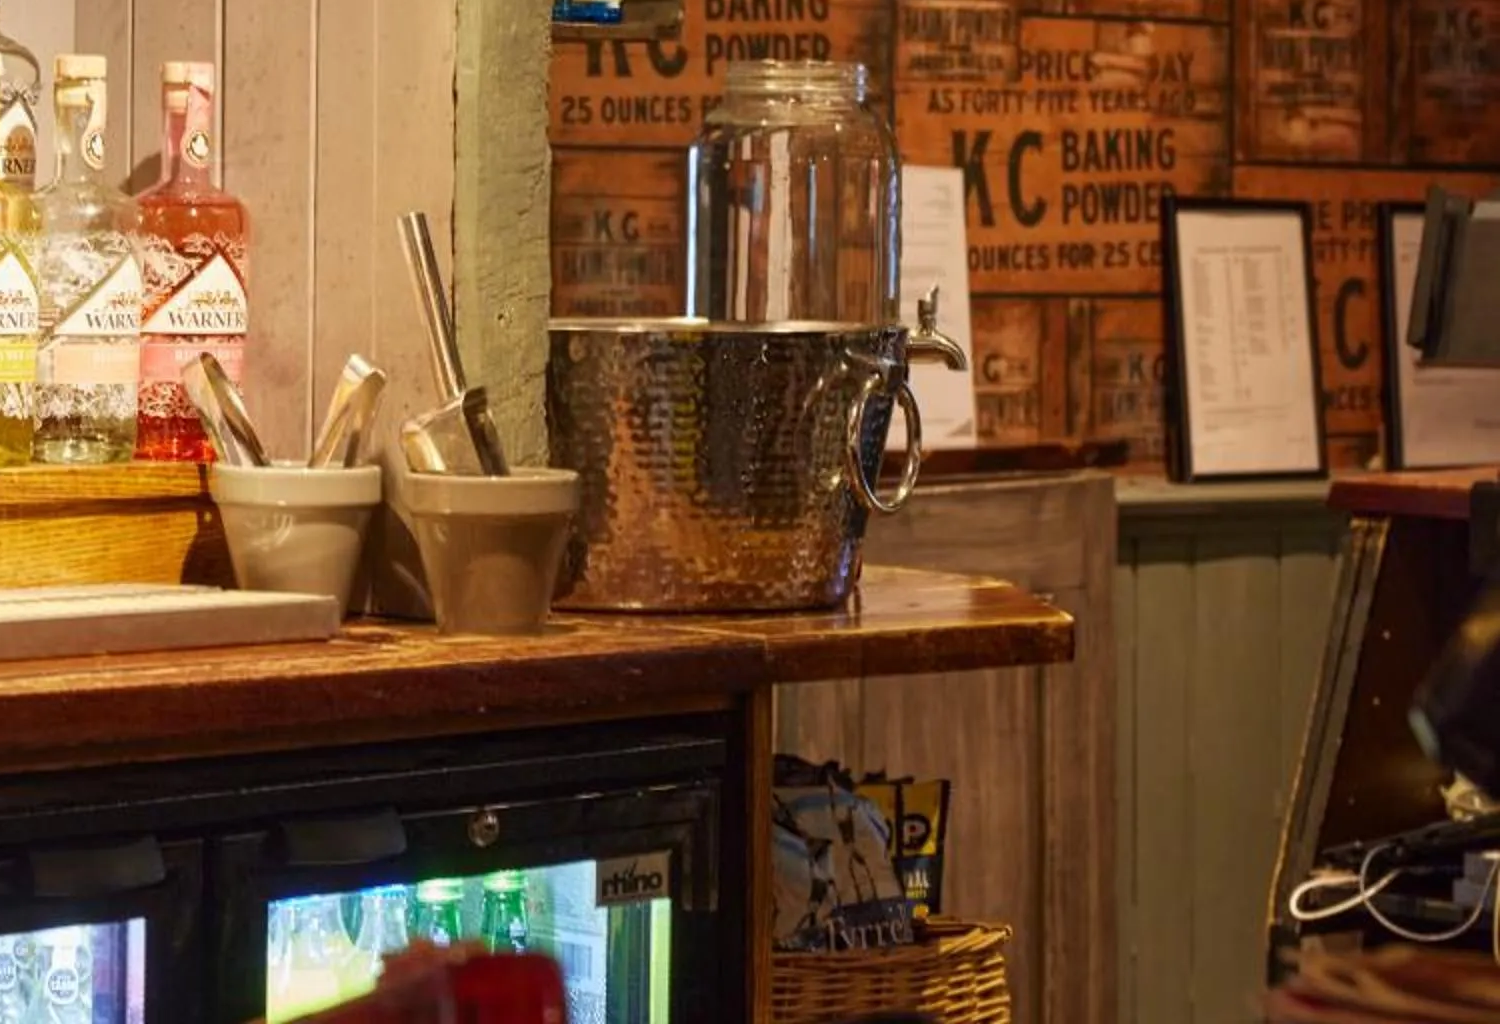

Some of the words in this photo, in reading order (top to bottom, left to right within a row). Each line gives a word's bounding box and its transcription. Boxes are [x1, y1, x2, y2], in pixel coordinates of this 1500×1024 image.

[561, 96, 593, 124] 25
[601, 96, 692, 125] OUNCES
[927, 88, 955, 114] AS
[1088, 90, 1151, 114] YEARS
[1060, 128, 1177, 173] BAKING
[951, 128, 1047, 228] KC
[968, 242, 1050, 271] OUNCES
[1056, 244, 1097, 269] FOR
[1103, 241, 1131, 267] 25
[601, 860, 663, 895] rhino
